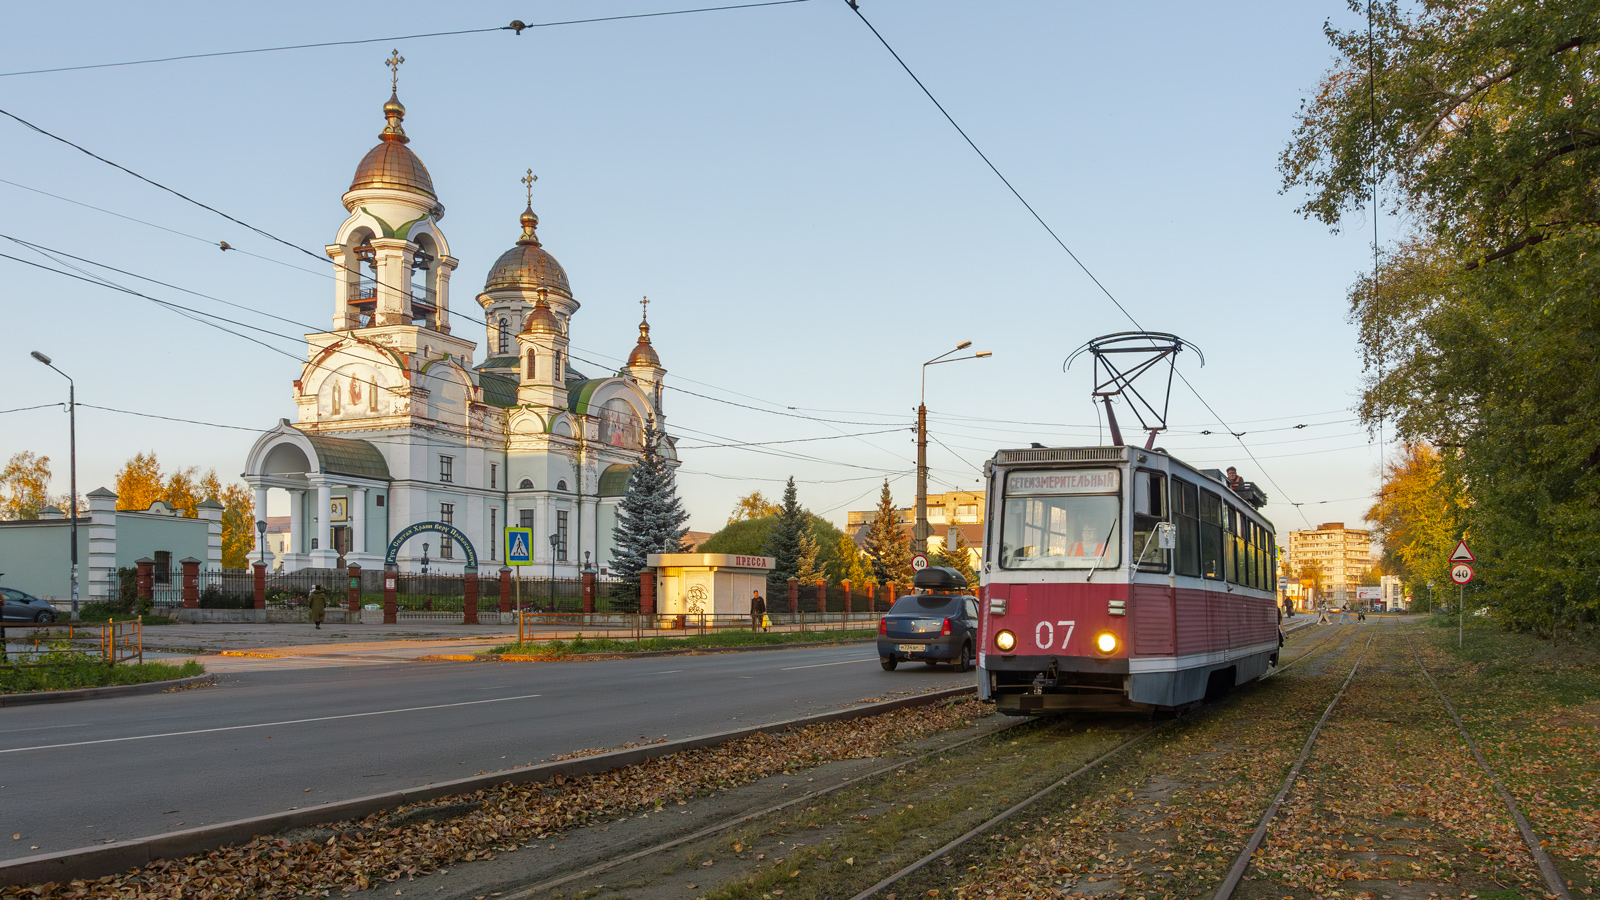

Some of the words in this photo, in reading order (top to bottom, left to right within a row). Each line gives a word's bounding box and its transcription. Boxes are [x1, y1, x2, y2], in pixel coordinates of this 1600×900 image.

[1010, 472, 1115, 489] СЕТЕИЗМЕРИТЕЛЬНЫЙ
[434, 524, 449, 532] Веру
[736, 556, 766, 567] ПРЕССА
[1455, 569, 1468, 578] 40
[1035, 620, 1075, 649] 07
